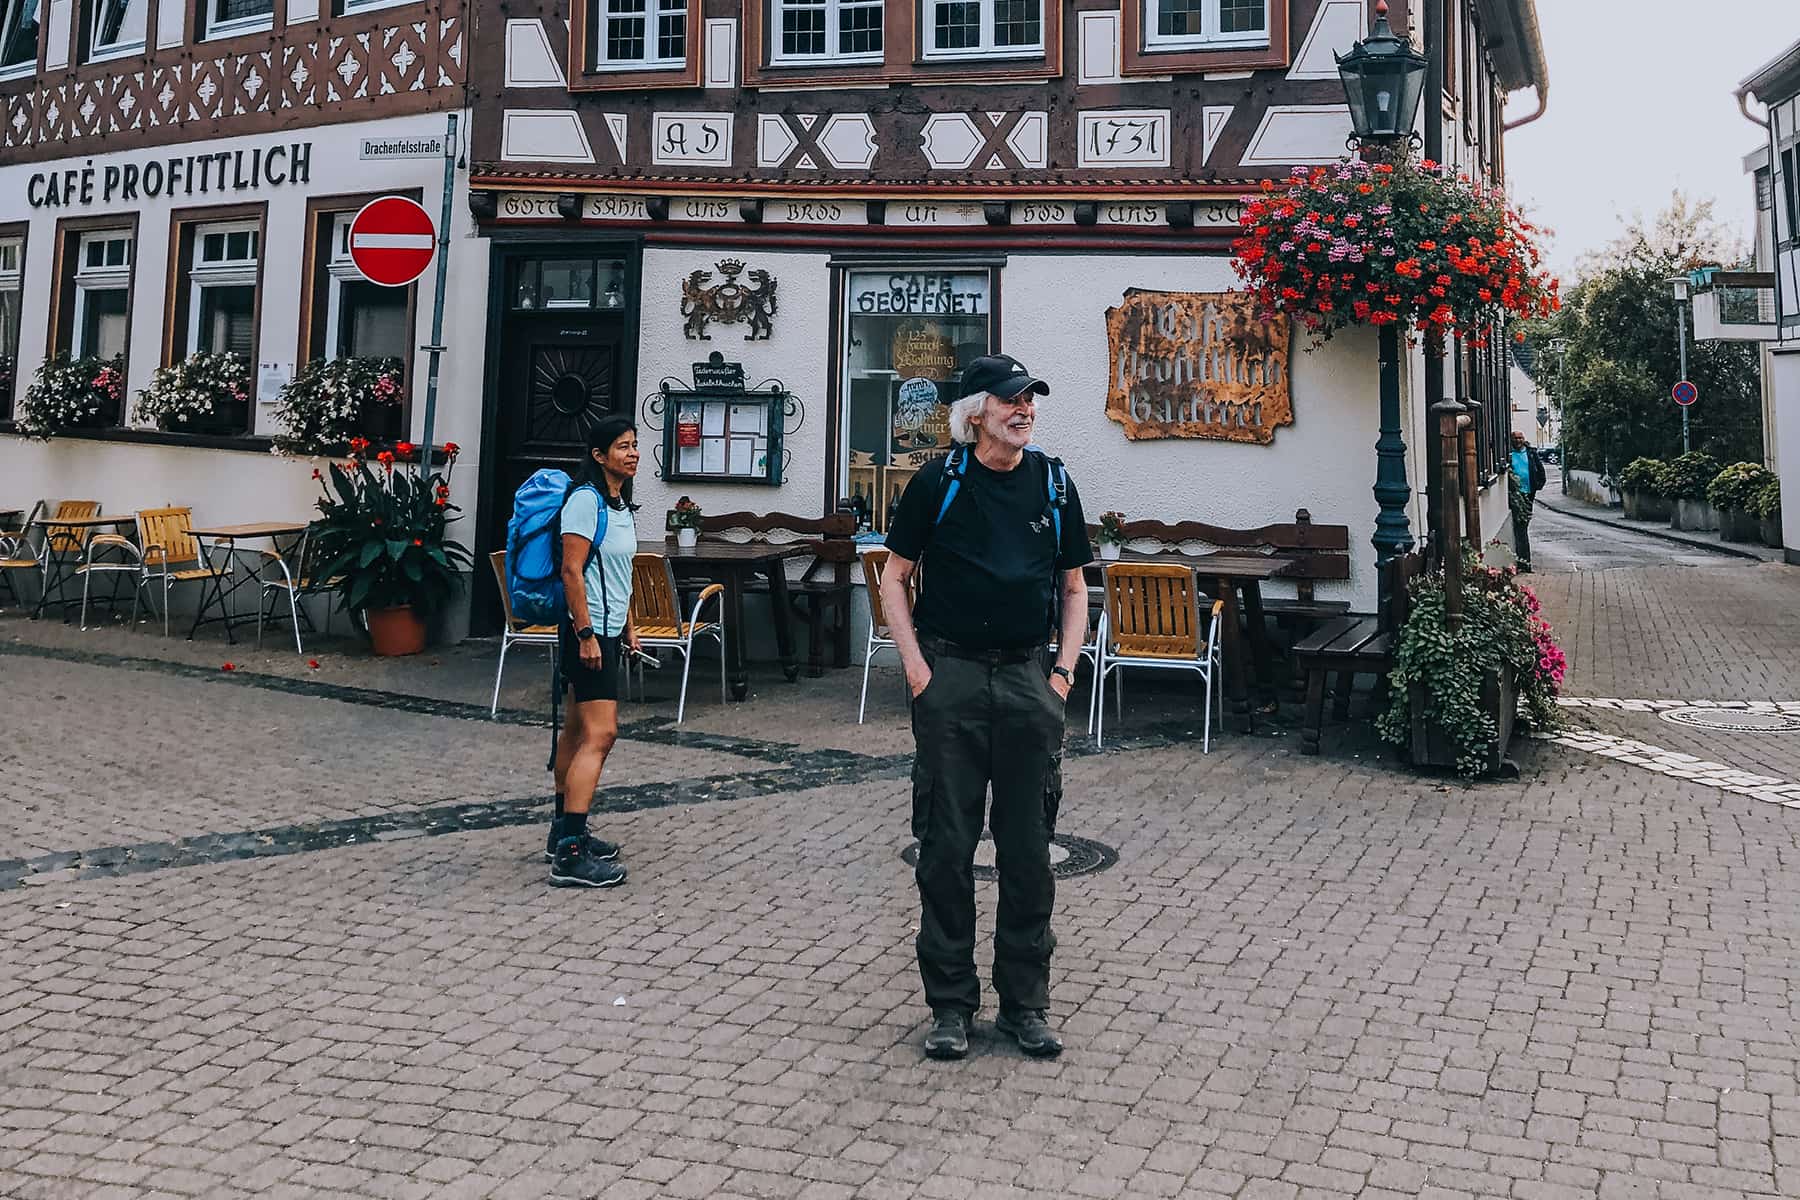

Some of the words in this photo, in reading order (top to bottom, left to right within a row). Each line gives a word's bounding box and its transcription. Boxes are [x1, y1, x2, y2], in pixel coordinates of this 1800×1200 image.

[365, 139, 441, 155] Drachenfelsstraße
[662, 122, 688, 155] A
[1090, 120, 1159, 156] 1731
[27, 159, 95, 208] CAFÉ
[103, 143, 313, 201] PROFITTLICH
